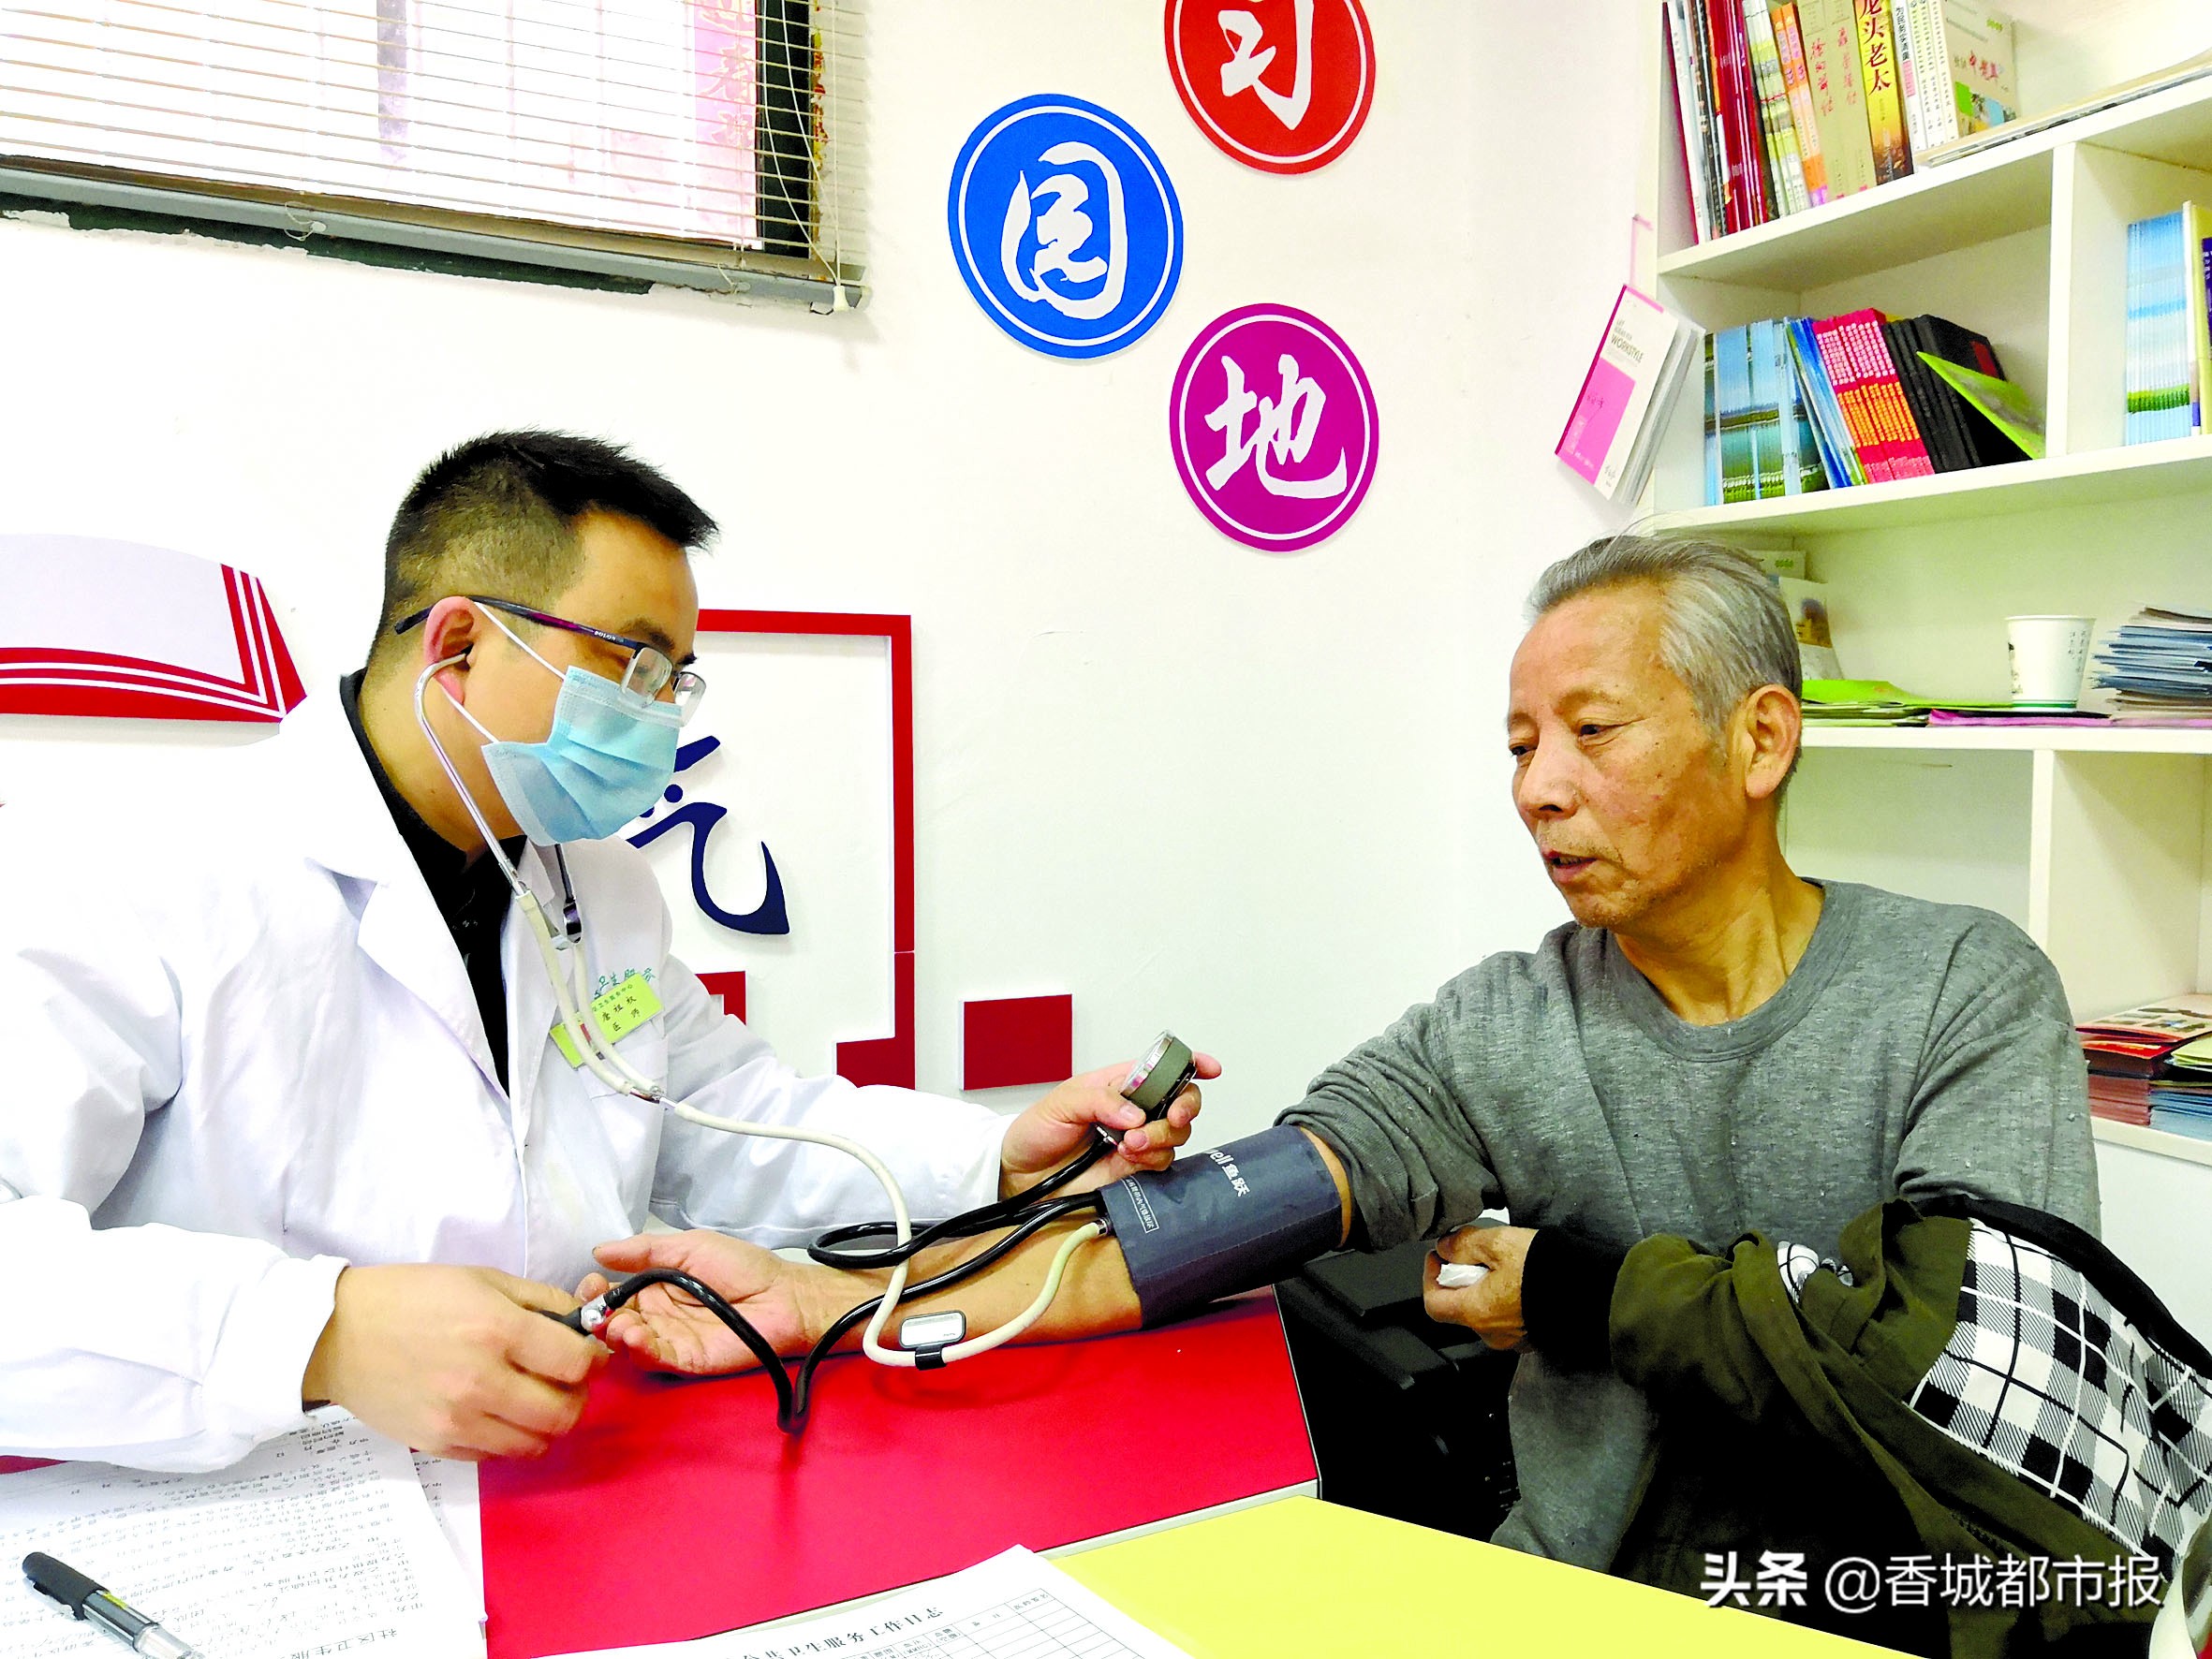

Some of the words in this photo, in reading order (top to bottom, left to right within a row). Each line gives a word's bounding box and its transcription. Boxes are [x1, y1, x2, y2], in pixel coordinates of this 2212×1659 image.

[1611, 334, 1644, 364] WORKSTYLE
[1204, 354, 1348, 499] 地
[1221, 1163, 1251, 1197] 鱼跃
